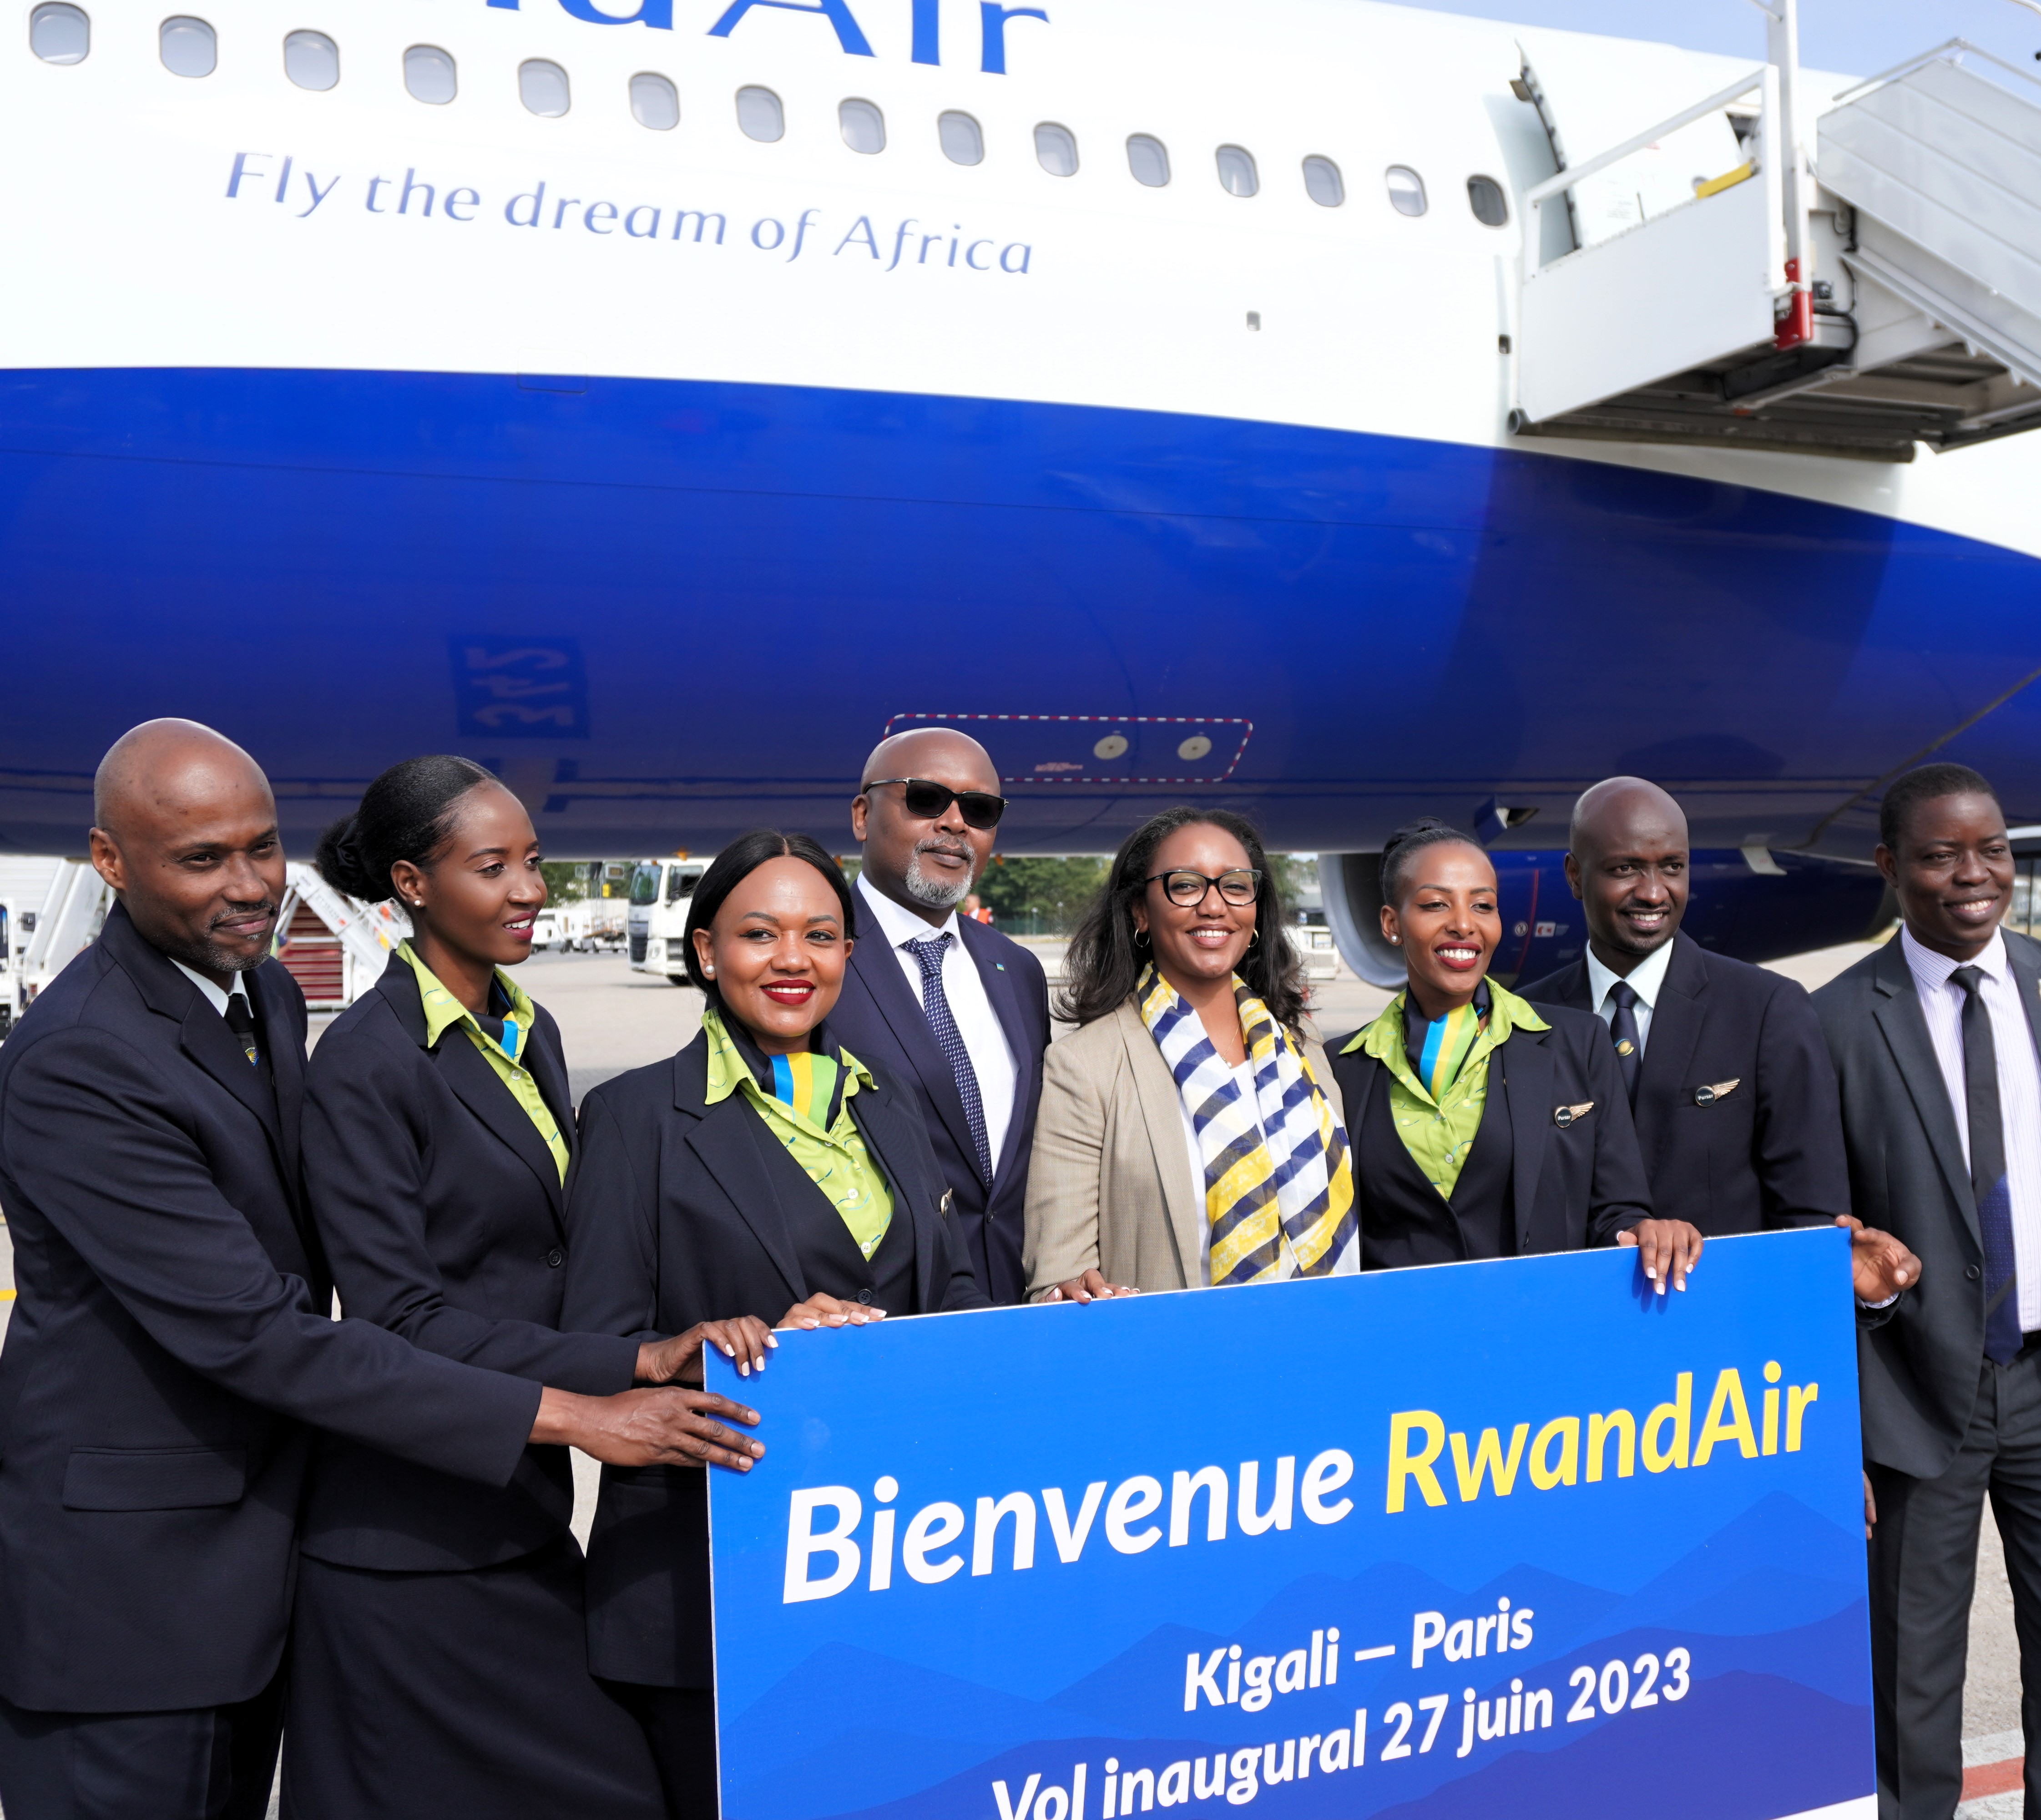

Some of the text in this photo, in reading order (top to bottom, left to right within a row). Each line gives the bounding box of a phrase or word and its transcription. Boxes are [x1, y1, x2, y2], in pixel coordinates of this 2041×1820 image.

[226, 152, 1032, 274] Fly the dream of Africa
[783, 1362, 1819, 1604] Bienvenue RwandAir
[1184, 1628, 1340, 1712] Kigali
[1412, 1597, 1534, 1669] Paris
[992, 1647, 1690, 1820] Vol inaugural 27 juin 2023
